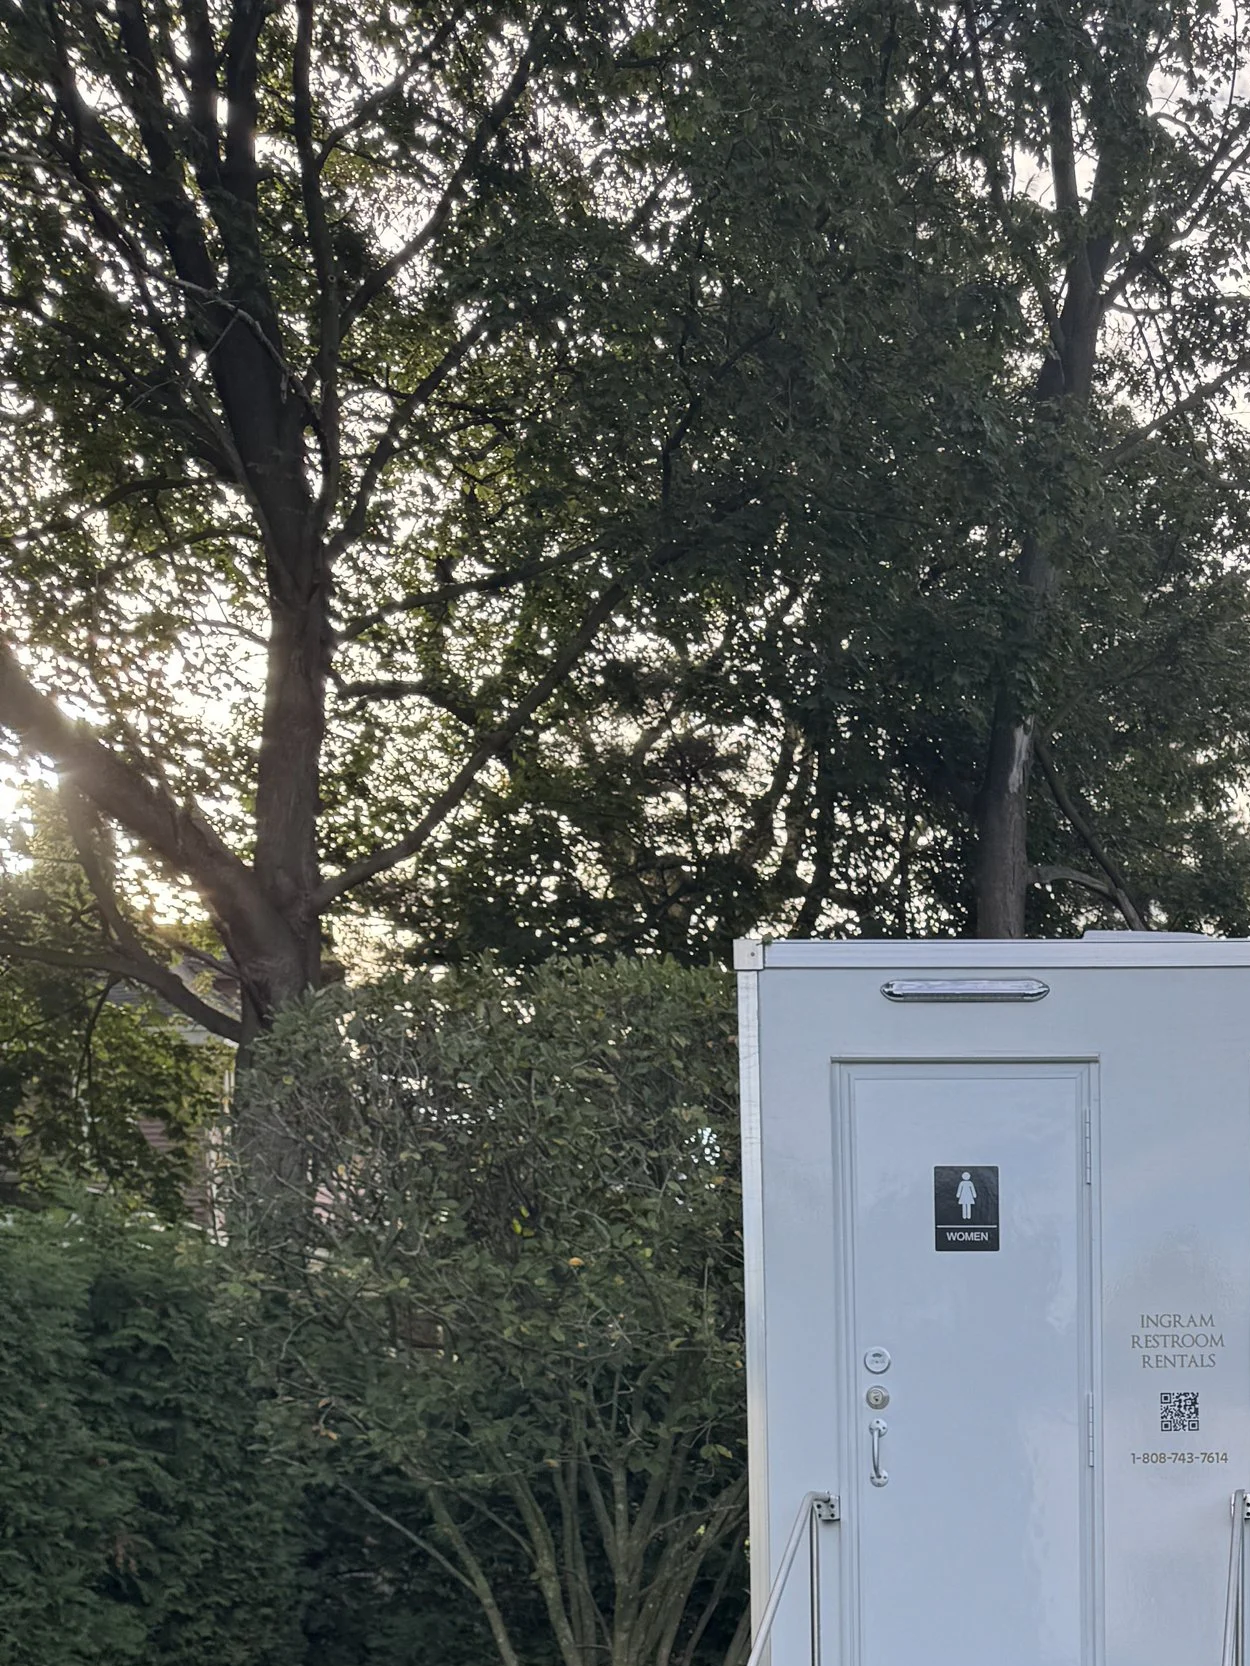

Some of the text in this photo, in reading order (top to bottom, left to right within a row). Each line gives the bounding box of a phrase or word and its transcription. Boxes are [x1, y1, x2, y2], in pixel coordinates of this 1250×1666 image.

[946, 1231, 989, 1241] WOMEN
[1140, 1314, 1215, 1328] INGRAM
[1131, 1333, 1225, 1348] RESTROOM
[1141, 1353, 1216, 1368] RENTALS
[1130, 1452, 1228, 1464] 1-808-743-7614
